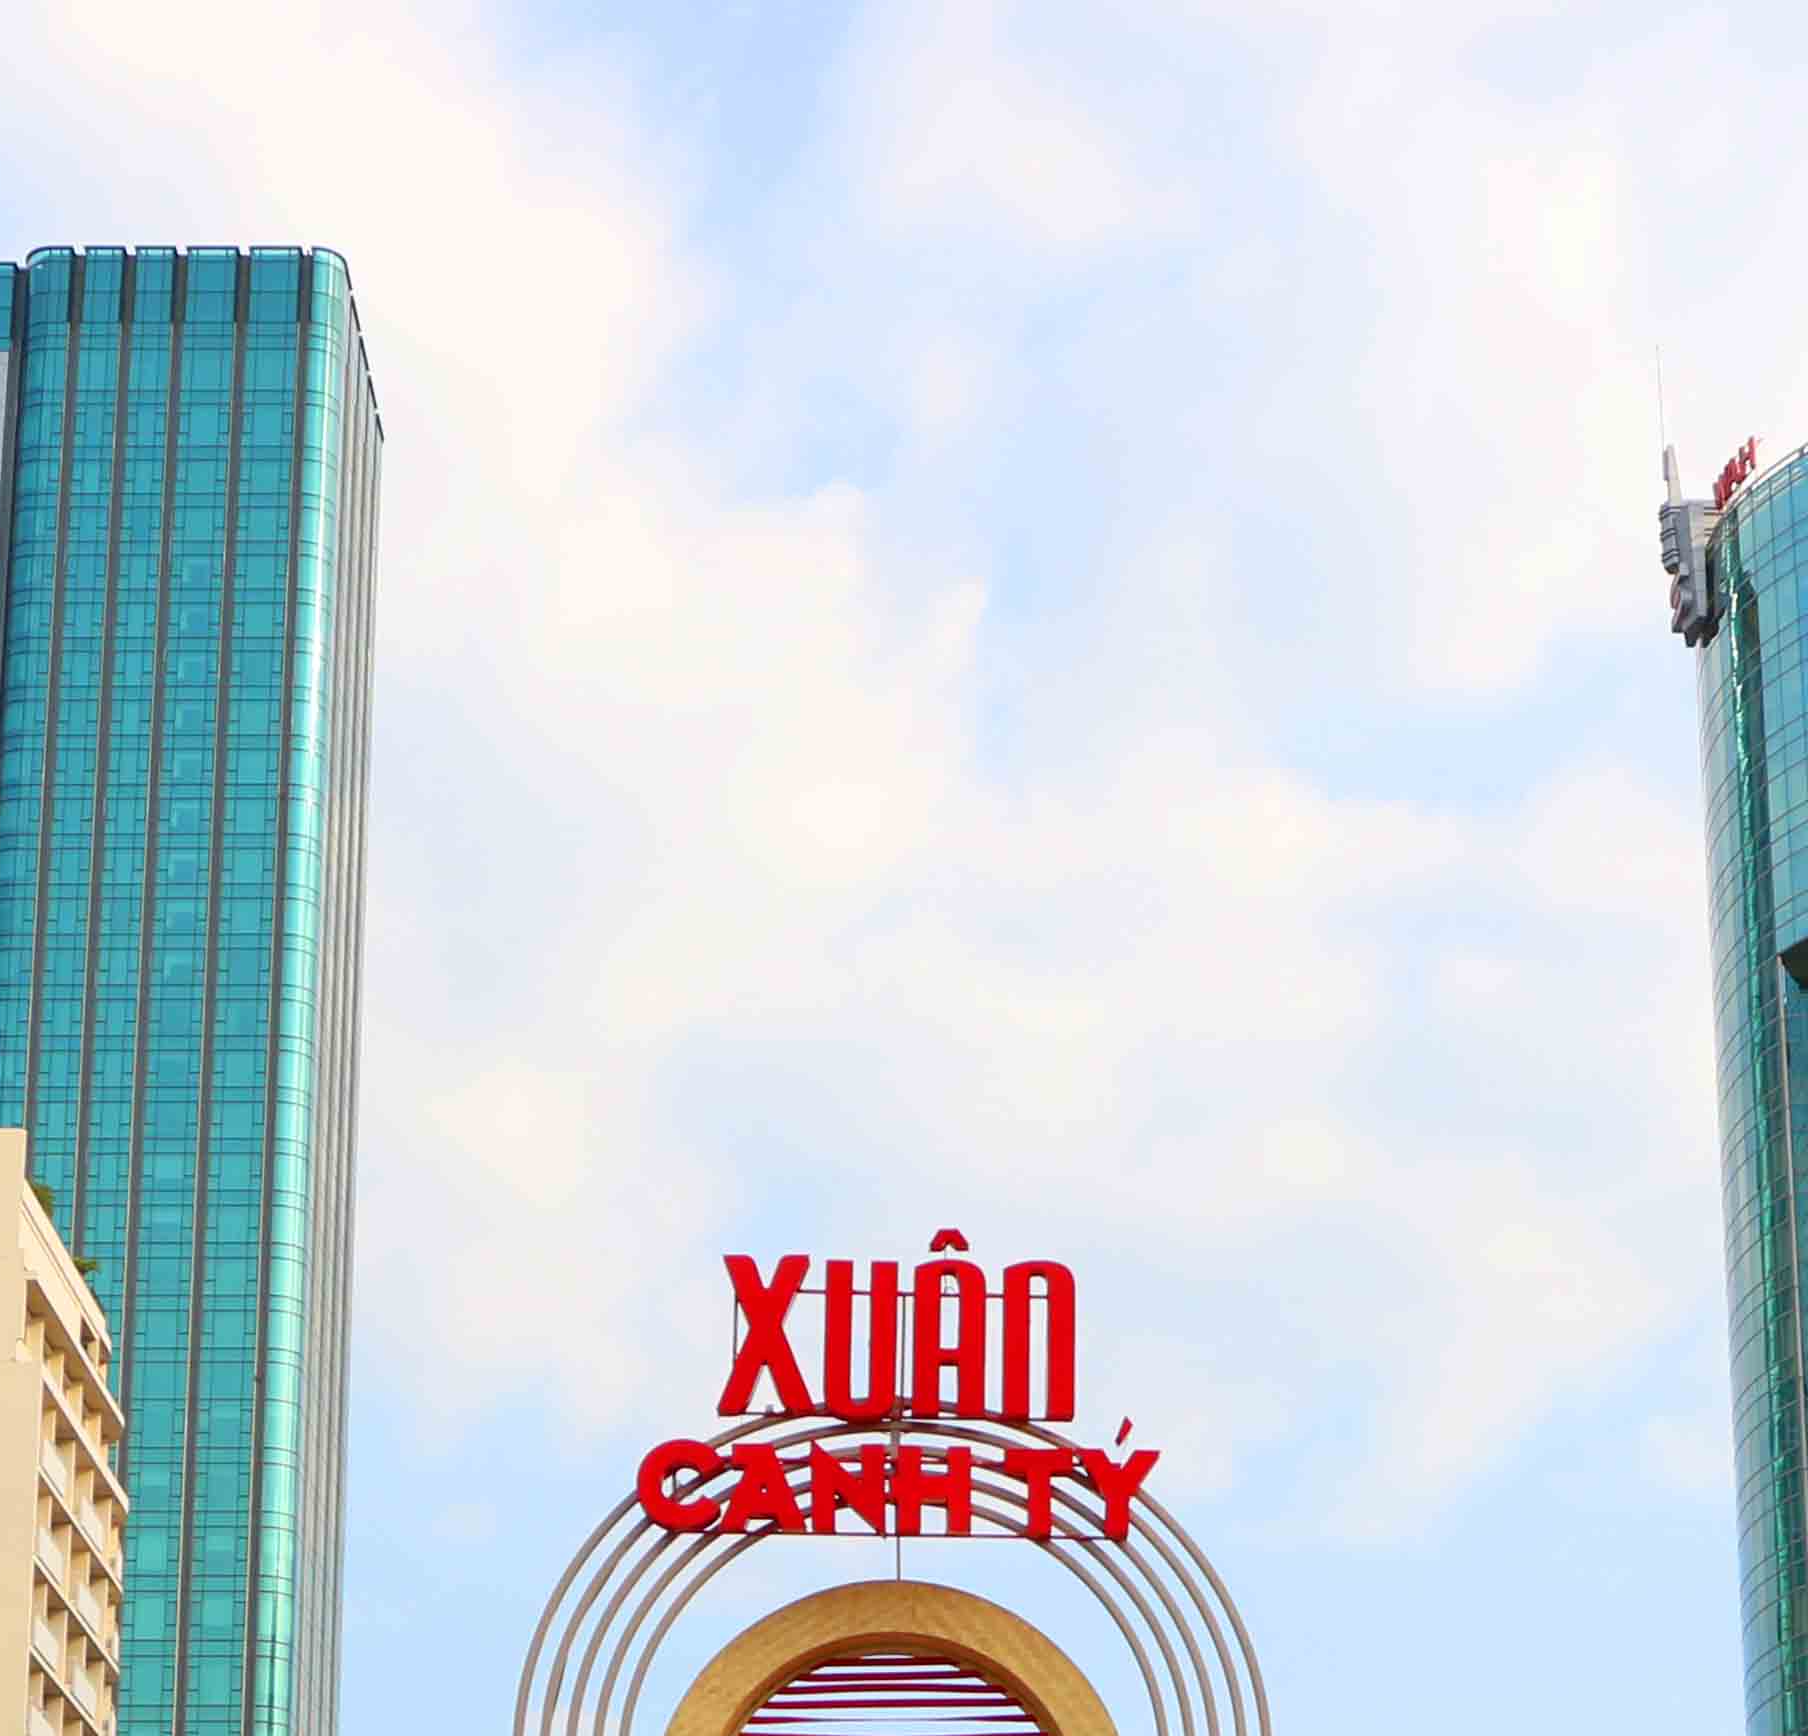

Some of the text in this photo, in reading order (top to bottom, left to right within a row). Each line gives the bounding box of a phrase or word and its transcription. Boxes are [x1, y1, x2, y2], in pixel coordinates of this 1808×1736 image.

[717, 1228, 1077, 1423] XUÂN
[637, 1417, 1161, 1542] CANH TÝ
